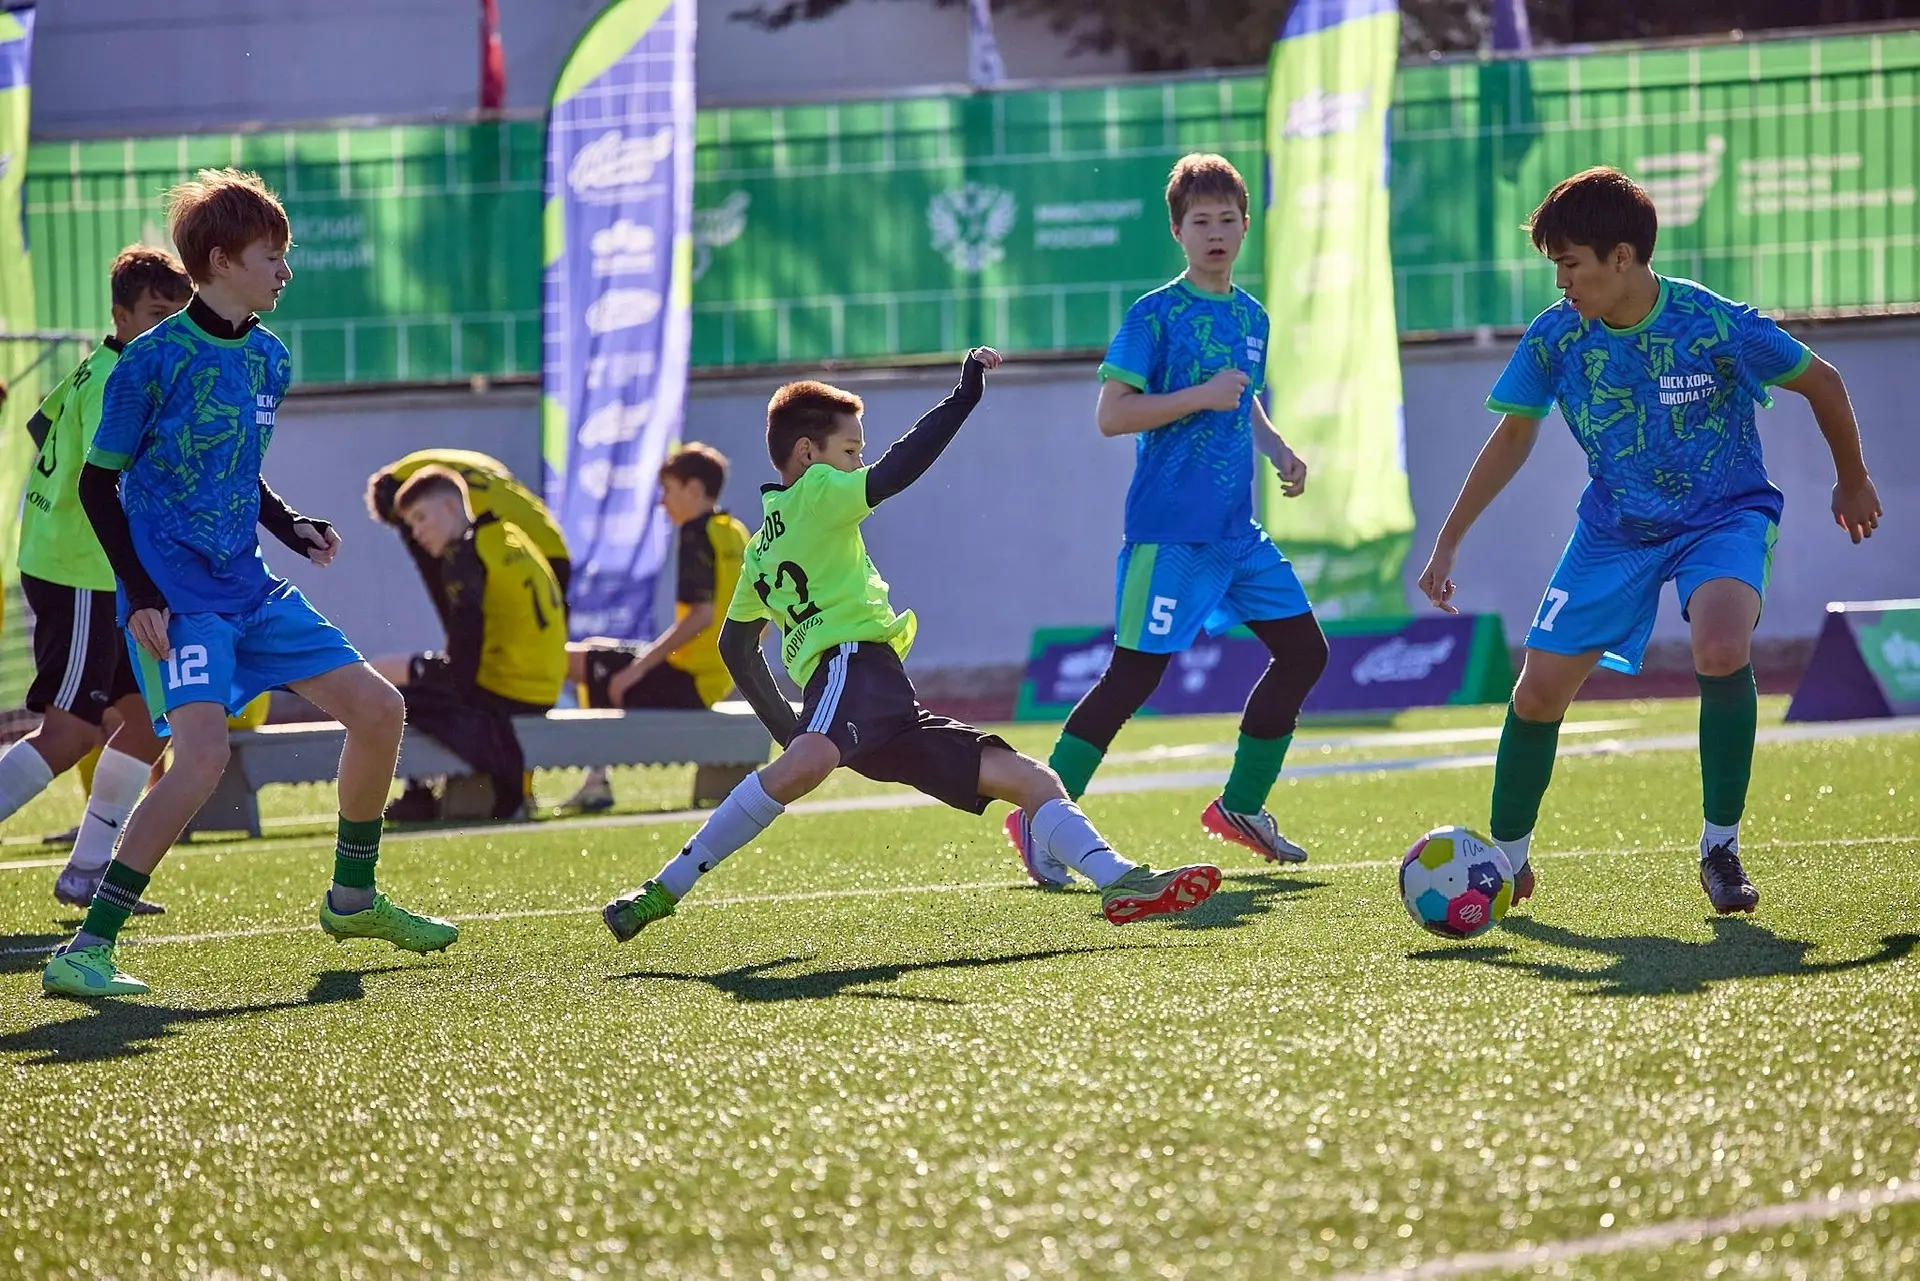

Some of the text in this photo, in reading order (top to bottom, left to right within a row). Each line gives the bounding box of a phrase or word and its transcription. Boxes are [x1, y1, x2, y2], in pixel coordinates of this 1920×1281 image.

[1660, 375, 1684, 389] ШСК
[1659, 390, 1699, 405] ШКОЛА
[1148, 595, 1178, 635] 5
[167, 644, 210, 690] 12
